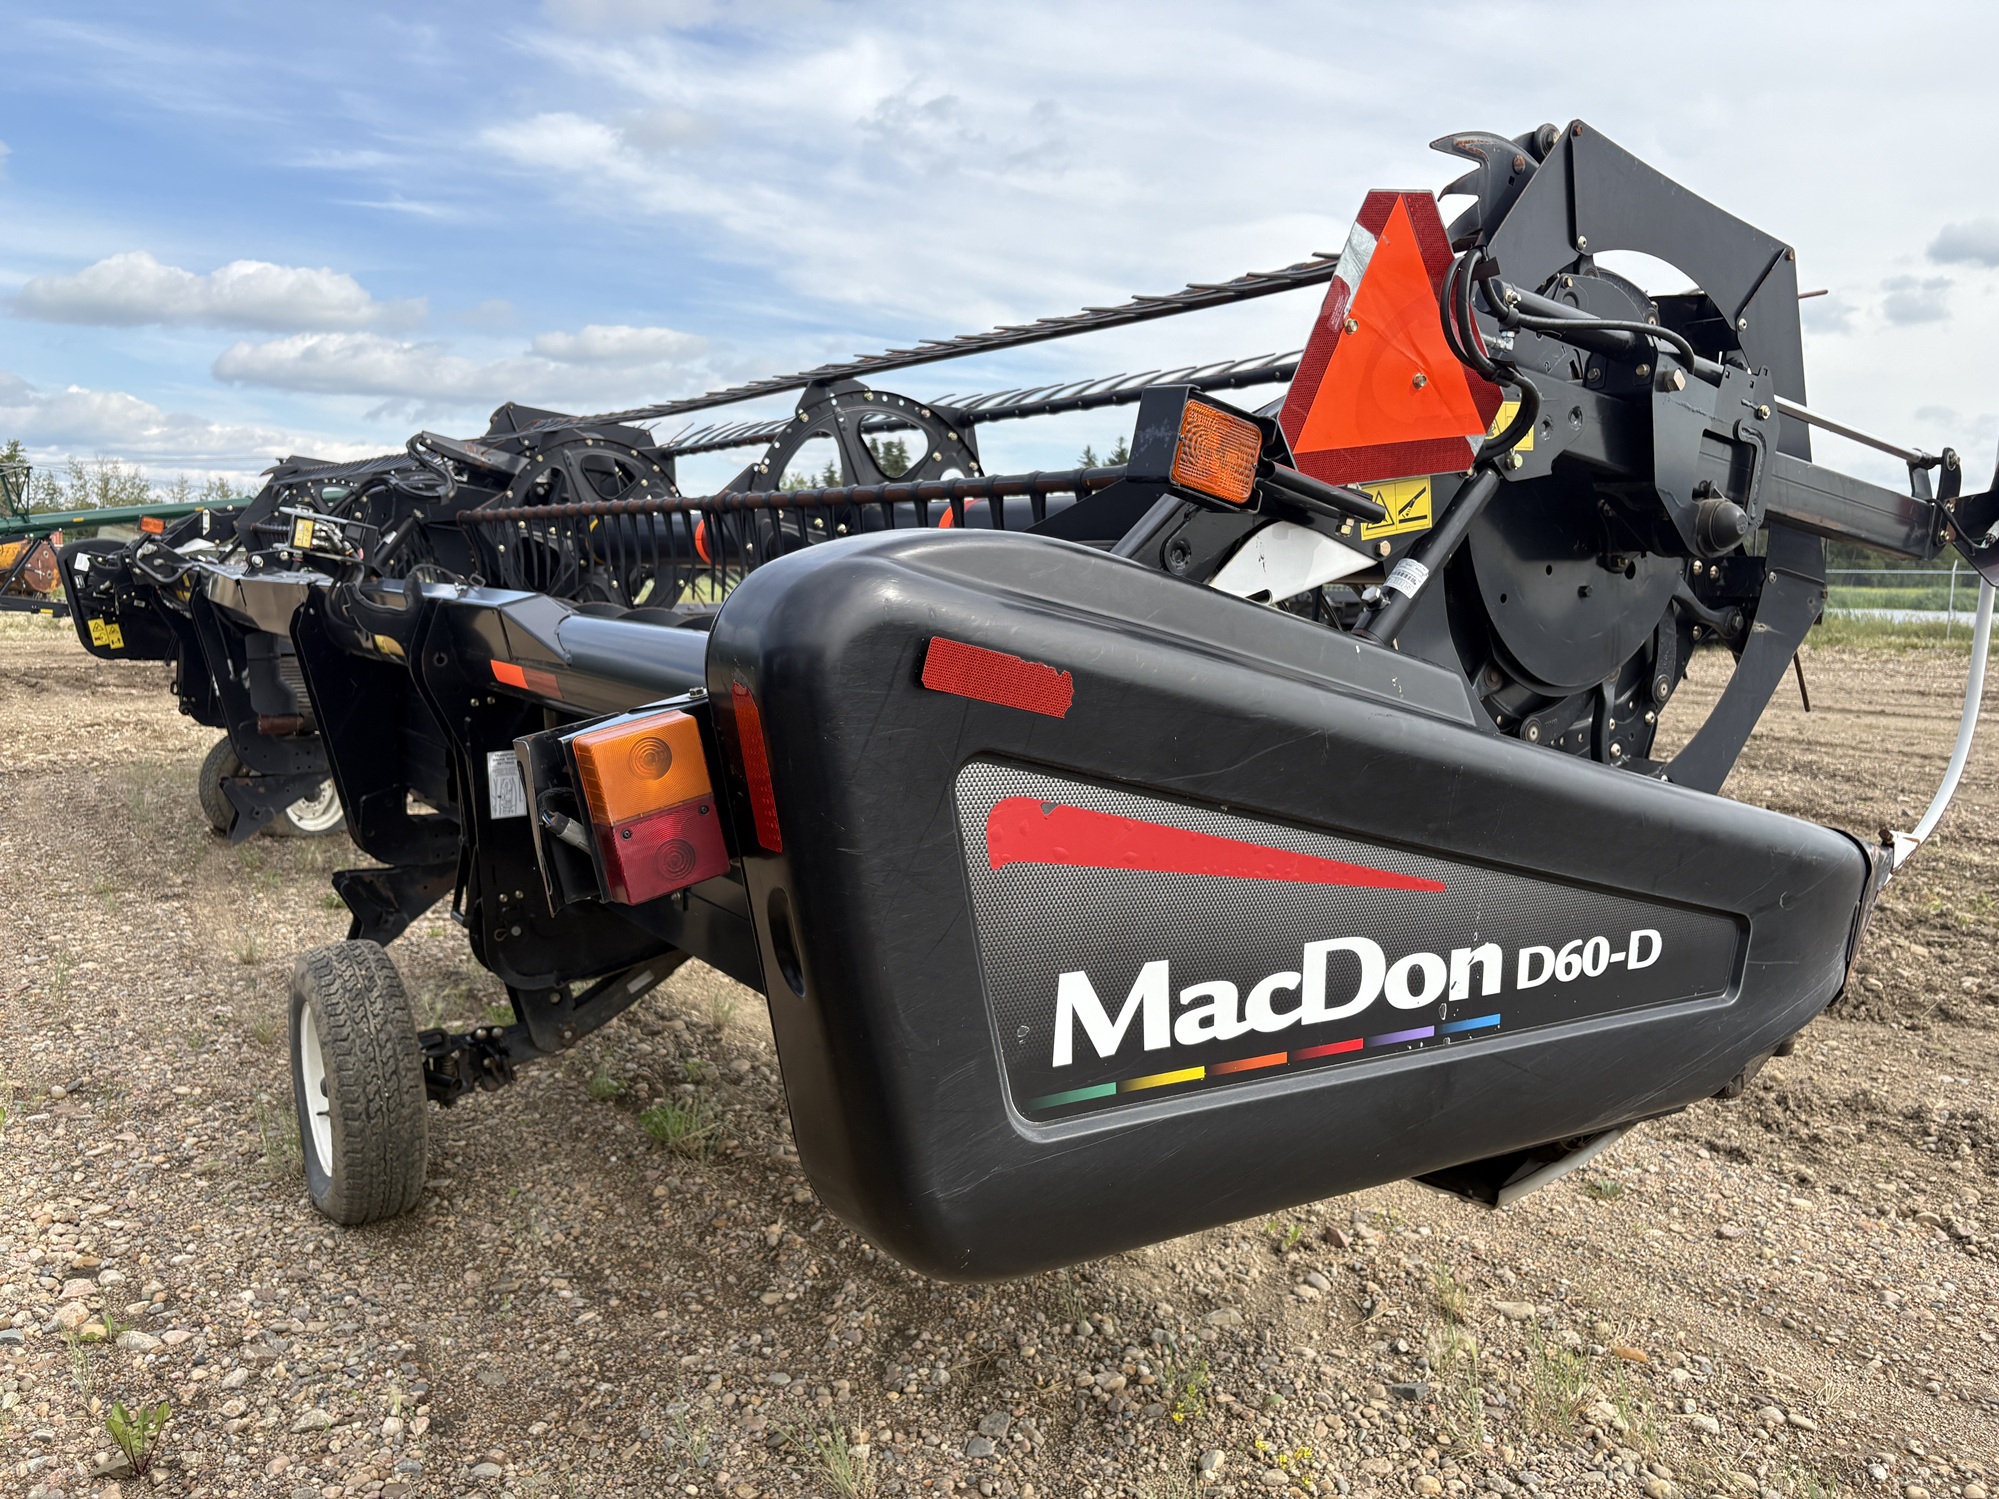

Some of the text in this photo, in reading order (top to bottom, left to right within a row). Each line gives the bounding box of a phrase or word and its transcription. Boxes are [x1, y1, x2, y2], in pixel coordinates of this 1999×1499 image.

[1544, 361, 1552, 373] 2
[1052, 928, 1663, 1068] MacDon D60-D
